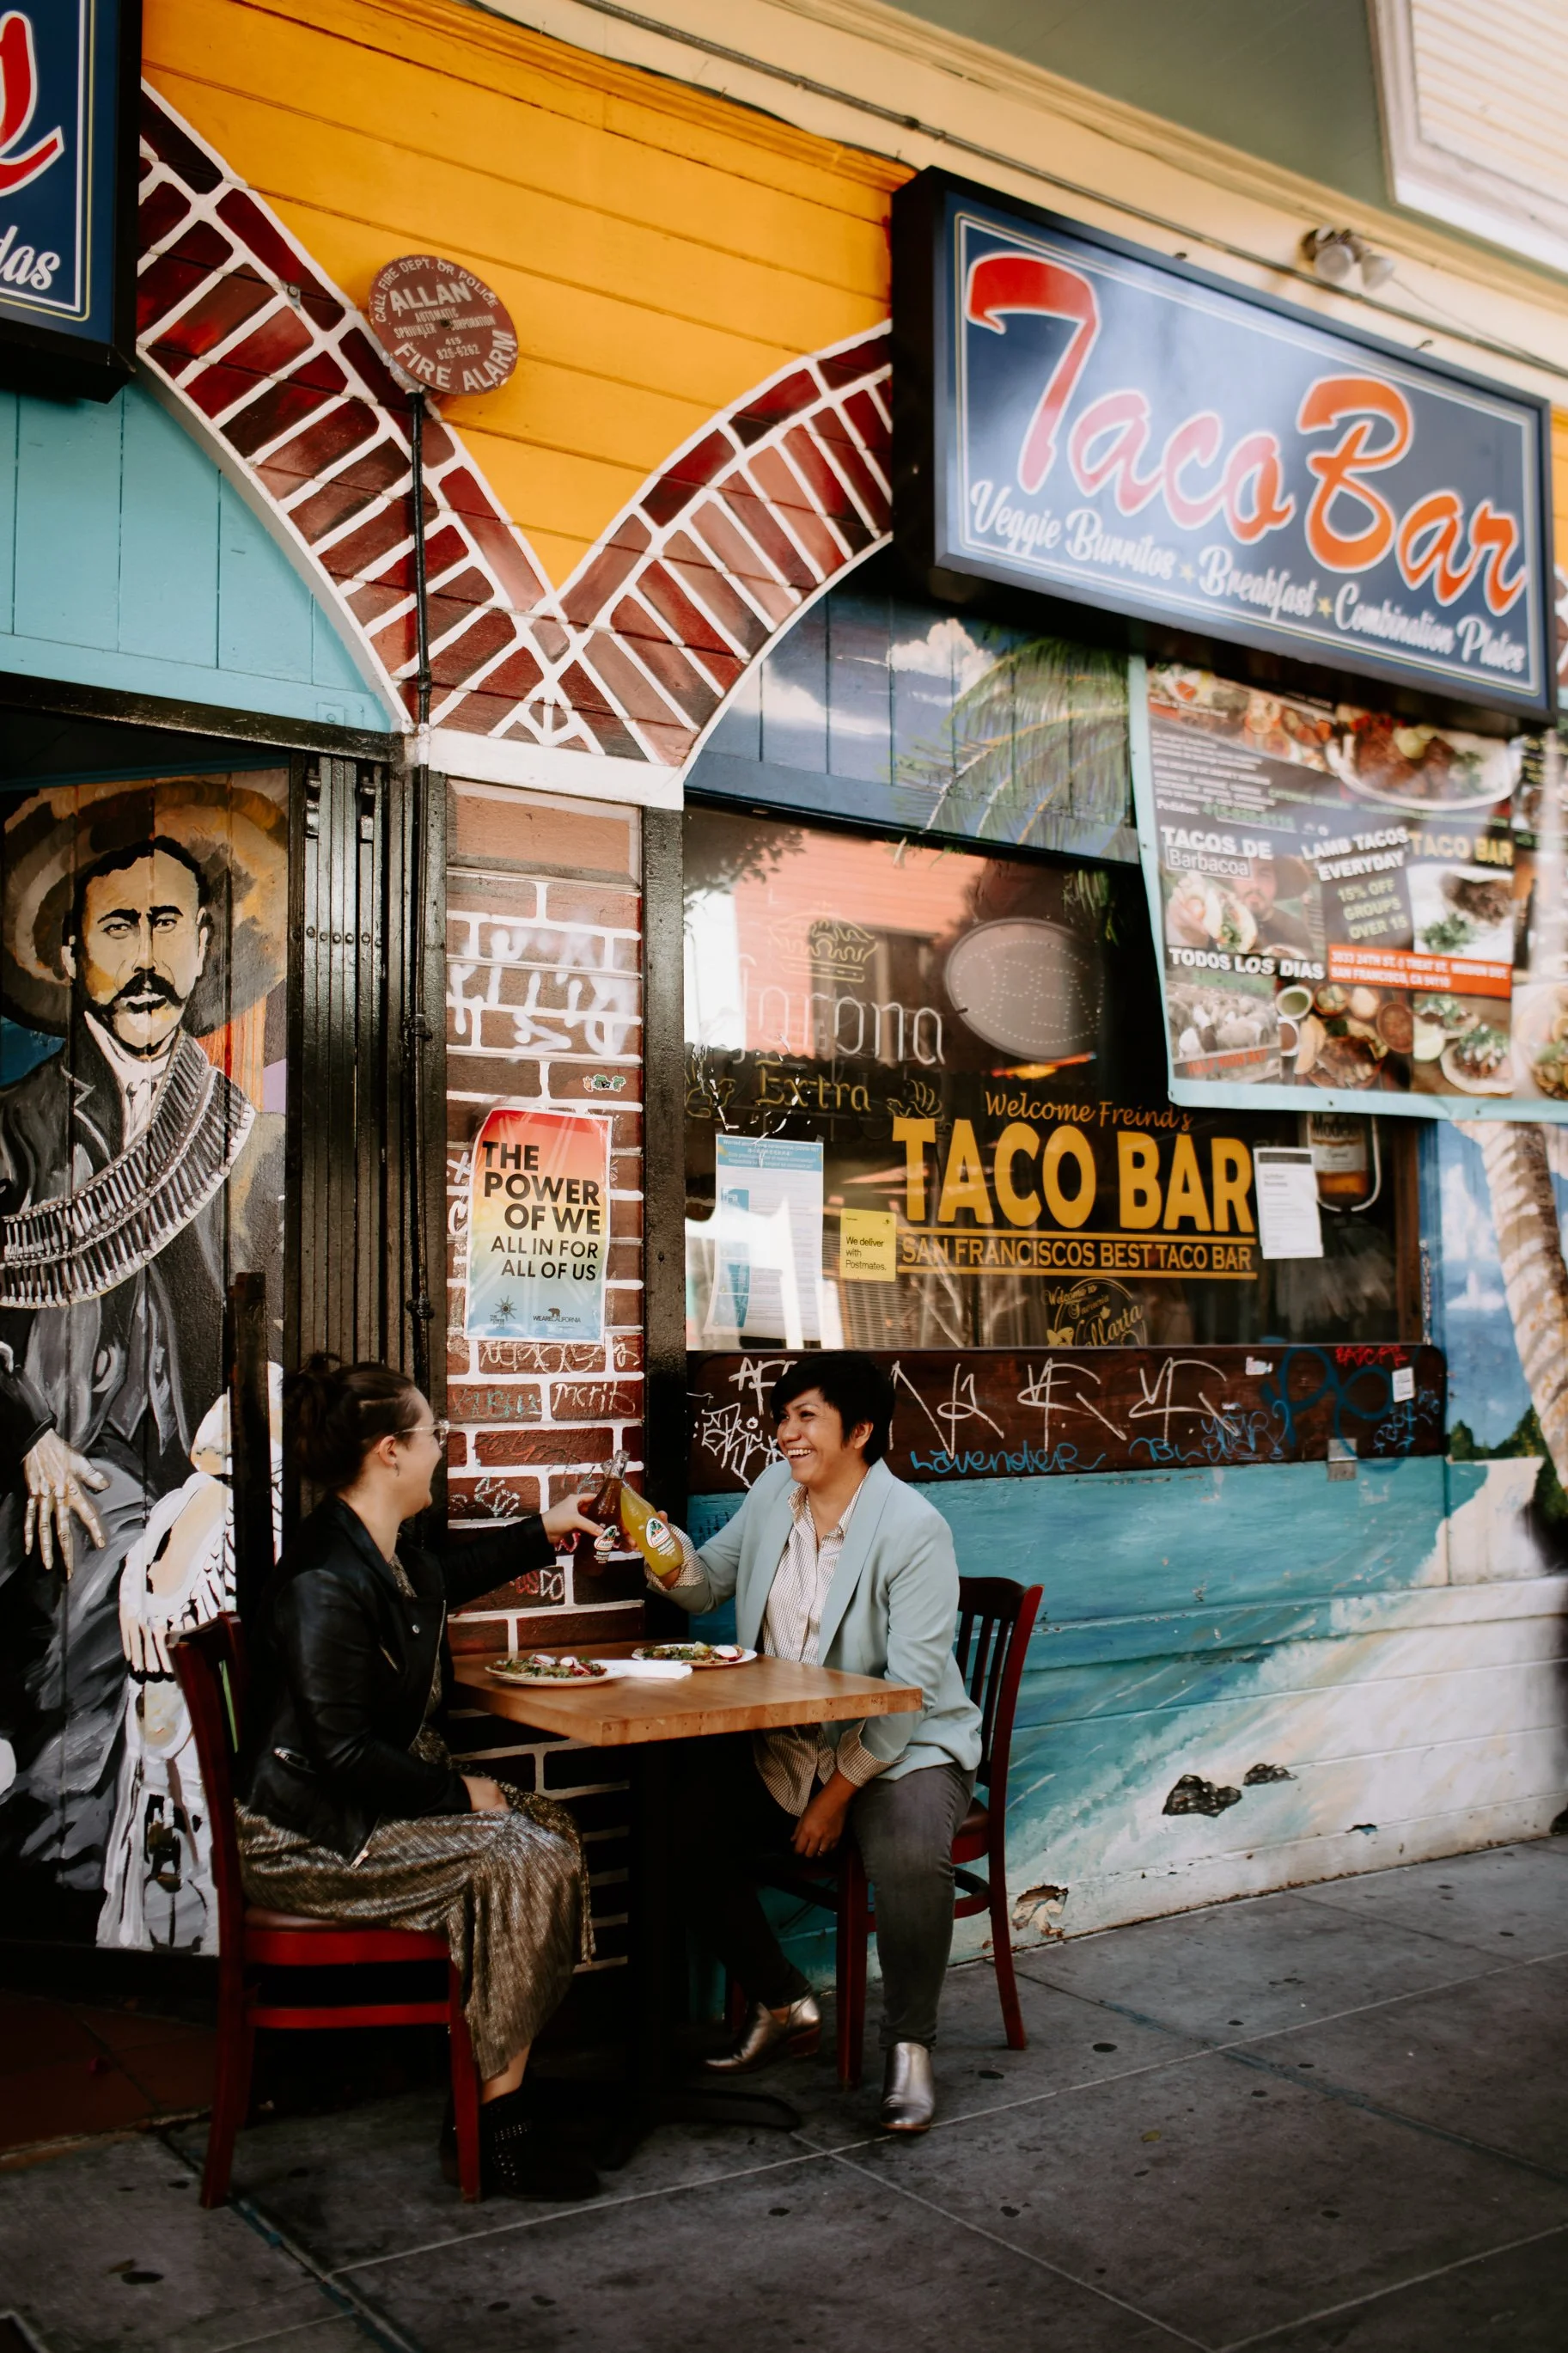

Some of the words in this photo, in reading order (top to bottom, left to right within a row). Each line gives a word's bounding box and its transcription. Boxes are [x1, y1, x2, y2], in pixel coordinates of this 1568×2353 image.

[378, 267, 400, 290] FIRE
[436, 259, 455, 275] OR
[389, 281, 473, 312] ALLAN
[458, 271, 498, 309] POLICE
[375, 292, 387, 323] CALL
[414, 307, 460, 324] AUTOMATIC
[394, 323, 437, 339] SPRINKLER
[450, 315, 497, 332] CORPORATION
[445, 336, 462, 346] 415
[394, 342, 452, 389] FIRE
[462, 329, 518, 392] ALARM
[964, 250, 1295, 546] Taco
[1296, 373, 1528, 617] Bar
[970, 480, 1062, 557] Veggie
[1065, 509, 1177, 581] Burritos
[1199, 545, 1318, 621] Breakfast
[1333, 581, 1455, 656] Combination
[1456, 614, 1527, 674] Plates
[1160, 826, 1237, 856] TACOS
[1242, 839, 1274, 860] DE
[1301, 838, 1352, 860] LAMB
[1352, 826, 1410, 852] TACOS
[1407, 830, 1473, 860] TACO
[1473, 836, 1515, 867] BAR
[1169, 849, 1249, 877] Barbacoa
[1317, 849, 1406, 882] EVERYDAY
[1337, 883, 1368, 902] 15%
[1368, 877, 1396, 897] OFF
[1343, 897, 1403, 921] GROUPS
[1349, 920, 1388, 940] OVER
[1389, 915, 1409, 931] 15
[1168, 948, 1231, 971] TODOS
[1235, 955, 1275, 976] LOS
[1279, 959, 1326, 981] DIAS
[755, 1060, 871, 1112] Extra
[985, 1091, 1096, 1124] Welcome
[1098, 1100, 1193, 1132] Freind's
[483, 1141, 540, 1171] THE
[485, 1171, 600, 1207] POWER
[892, 1116, 1097, 1230] TACO
[1117, 1130, 1255, 1233] BAR
[504, 1203, 546, 1231] OF
[551, 1207, 601, 1236] WE
[491, 1236, 527, 1254] ALL
[533, 1238, 552, 1256] IN
[559, 1240, 599, 1259] FOR
[845, 1249, 862, 1257] with
[846, 1236, 857, 1244] We
[859, 1238, 884, 1247] deliver
[902, 1237, 949, 1266] SAN
[954, 1237, 1096, 1268] FRANCISCOS
[1100, 1242, 1155, 1269] BEST
[1156, 1244, 1209, 1271] TACO
[1211, 1246, 1253, 1271] BAR
[501, 1259, 536, 1277] ALL
[540, 1262, 567, 1280] OF
[572, 1263, 596, 1281] US
[845, 1259, 887, 1271] Postmates.
